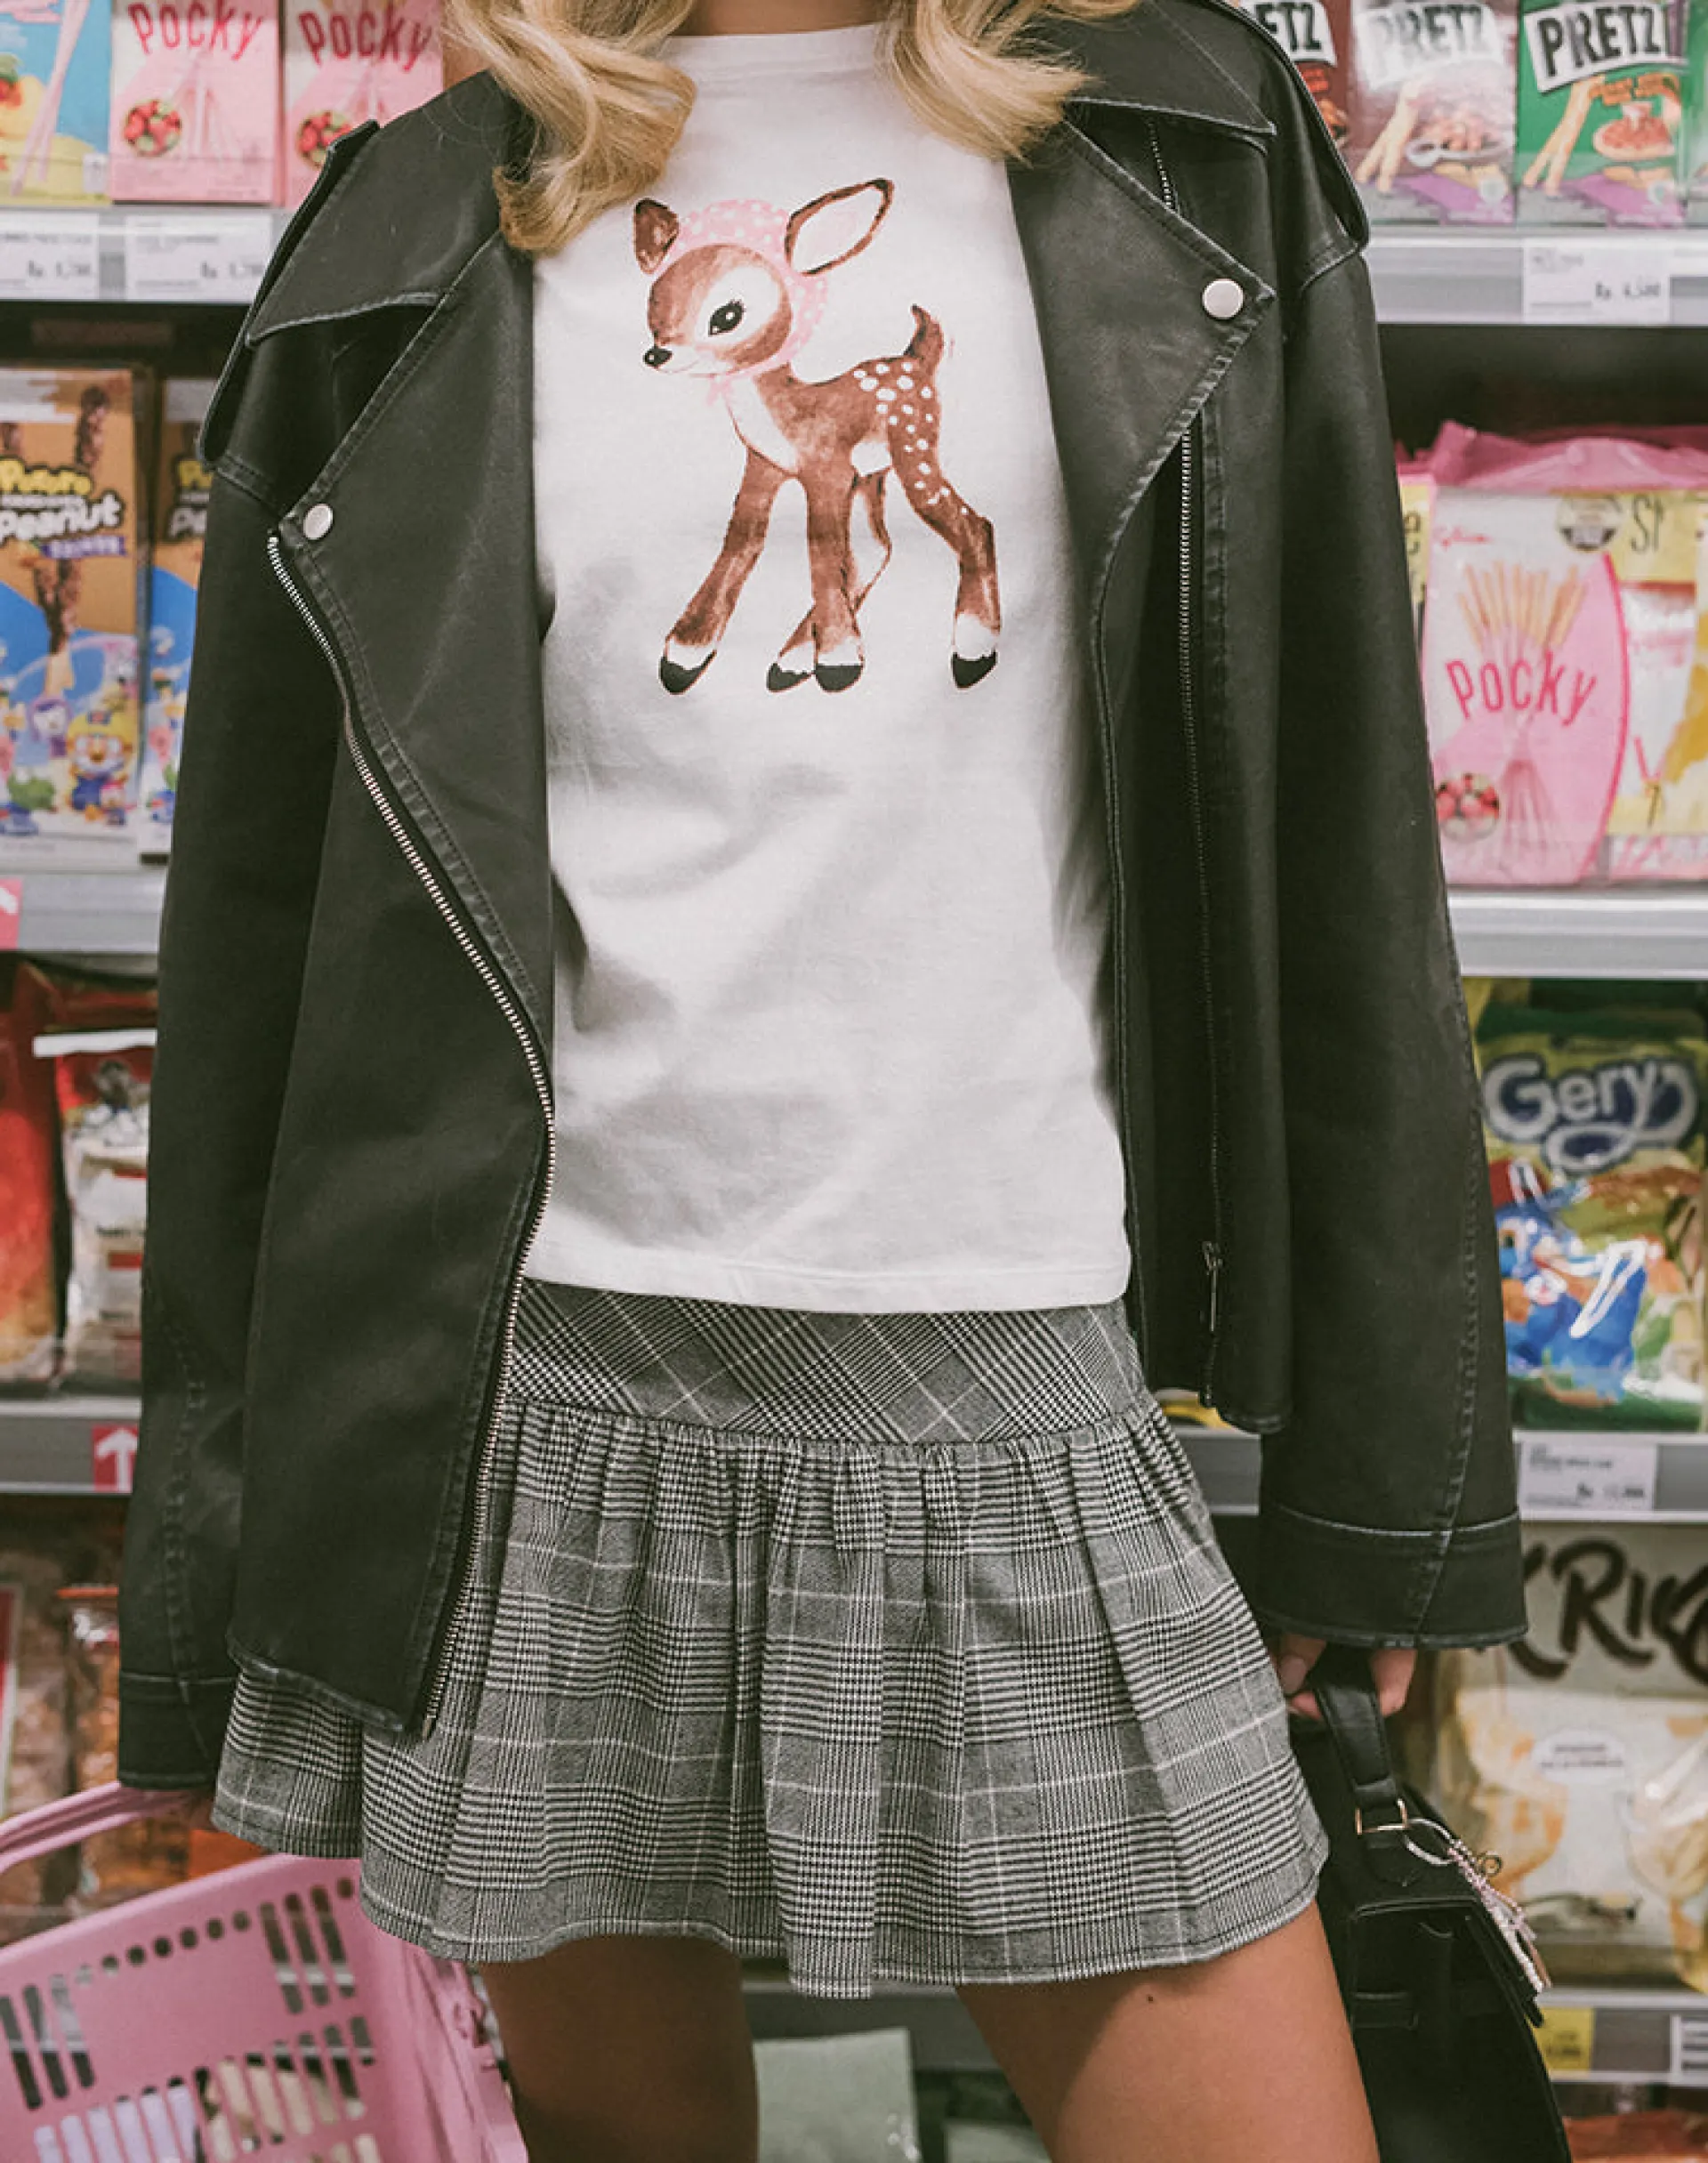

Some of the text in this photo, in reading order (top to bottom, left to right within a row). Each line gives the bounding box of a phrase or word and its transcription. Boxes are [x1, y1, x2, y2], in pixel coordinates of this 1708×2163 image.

[127, 0, 263, 61] POCKY
[297, 2, 432, 74] POCKY
[1537, 5, 1662, 77] PRETZ
[1445, 650, 1598, 728] POCKY
[1483, 1059, 1697, 1172] Gery
